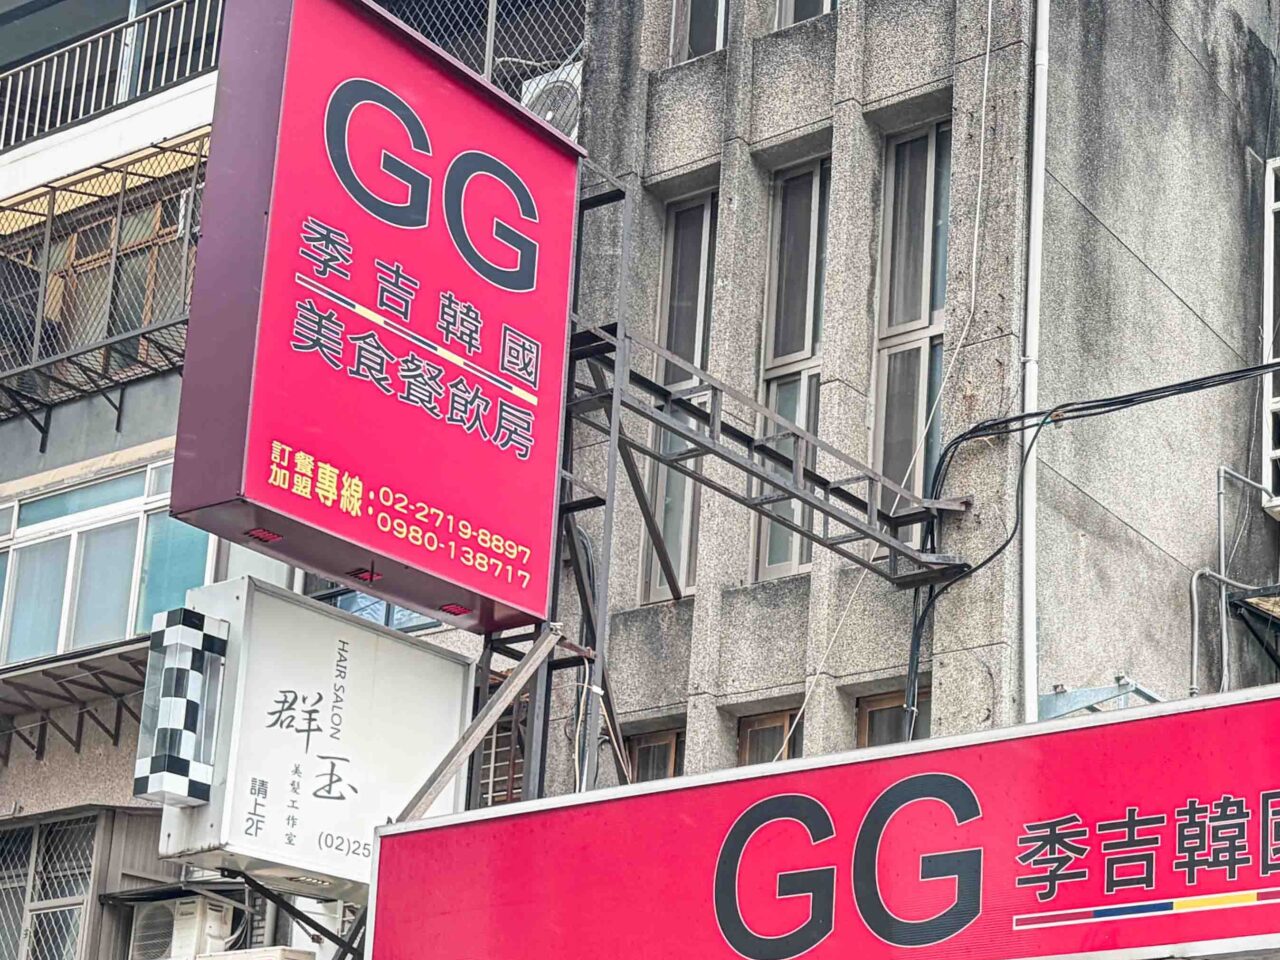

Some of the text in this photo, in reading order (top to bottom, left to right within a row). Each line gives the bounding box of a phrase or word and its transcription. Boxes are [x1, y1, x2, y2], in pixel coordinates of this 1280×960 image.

[324, 78, 539, 292] GG
[299, 216, 541, 389] 季吉韓國
[290, 299, 534, 460] 美食餐飲房
[268, 463, 313, 500] 加盟
[271, 440, 315, 478] 訂餐
[376, 512, 531, 589] 0980-138717
[379, 486, 531, 564] 02-2719-8897
[329, 639, 350, 741] HAIR SALON
